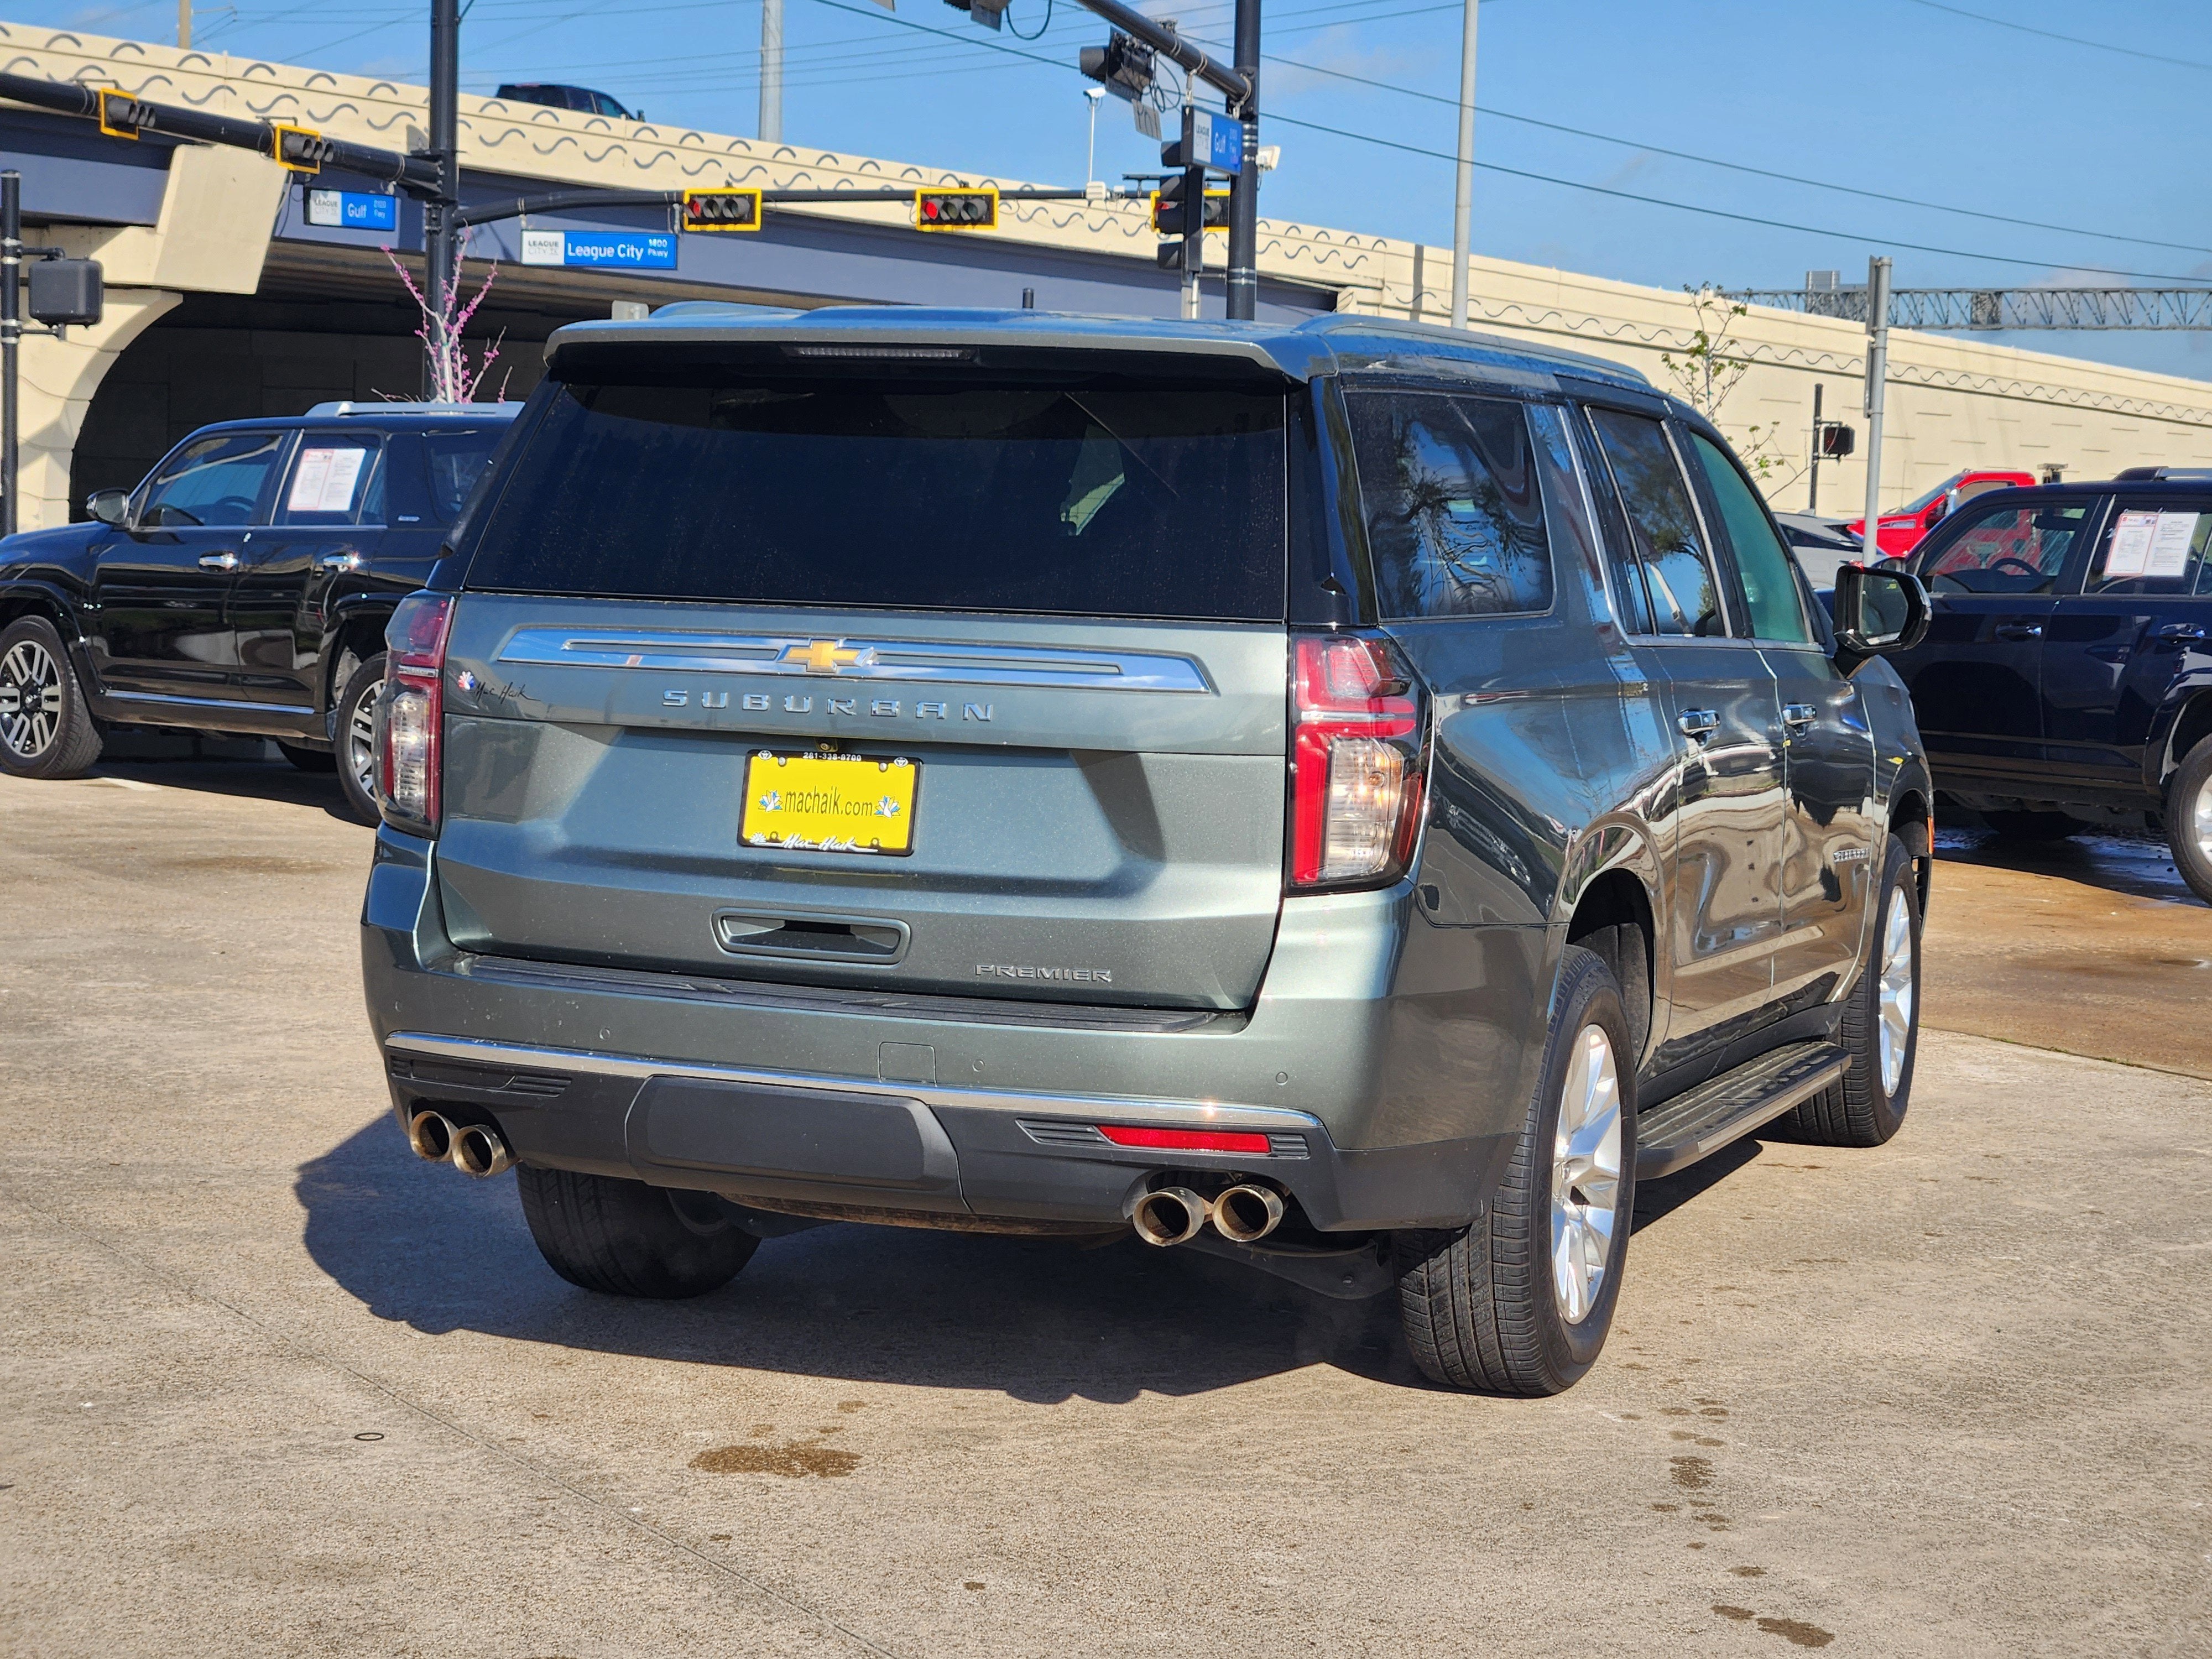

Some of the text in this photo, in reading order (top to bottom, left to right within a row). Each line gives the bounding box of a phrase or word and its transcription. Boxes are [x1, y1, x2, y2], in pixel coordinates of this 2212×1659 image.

[314, 199, 338, 207] LEAGUE
[347, 202, 367, 218] Gulf
[567, 242, 644, 262] League City
[648, 248, 669, 258] Pkwy
[474, 681, 541, 705] Mac Haik
[662, 689, 993, 722] SUBURBAN
[784, 785, 873, 817] machaik.com
[781, 832, 818, 849] Mac
[975, 964, 1112, 983] PREMIER
